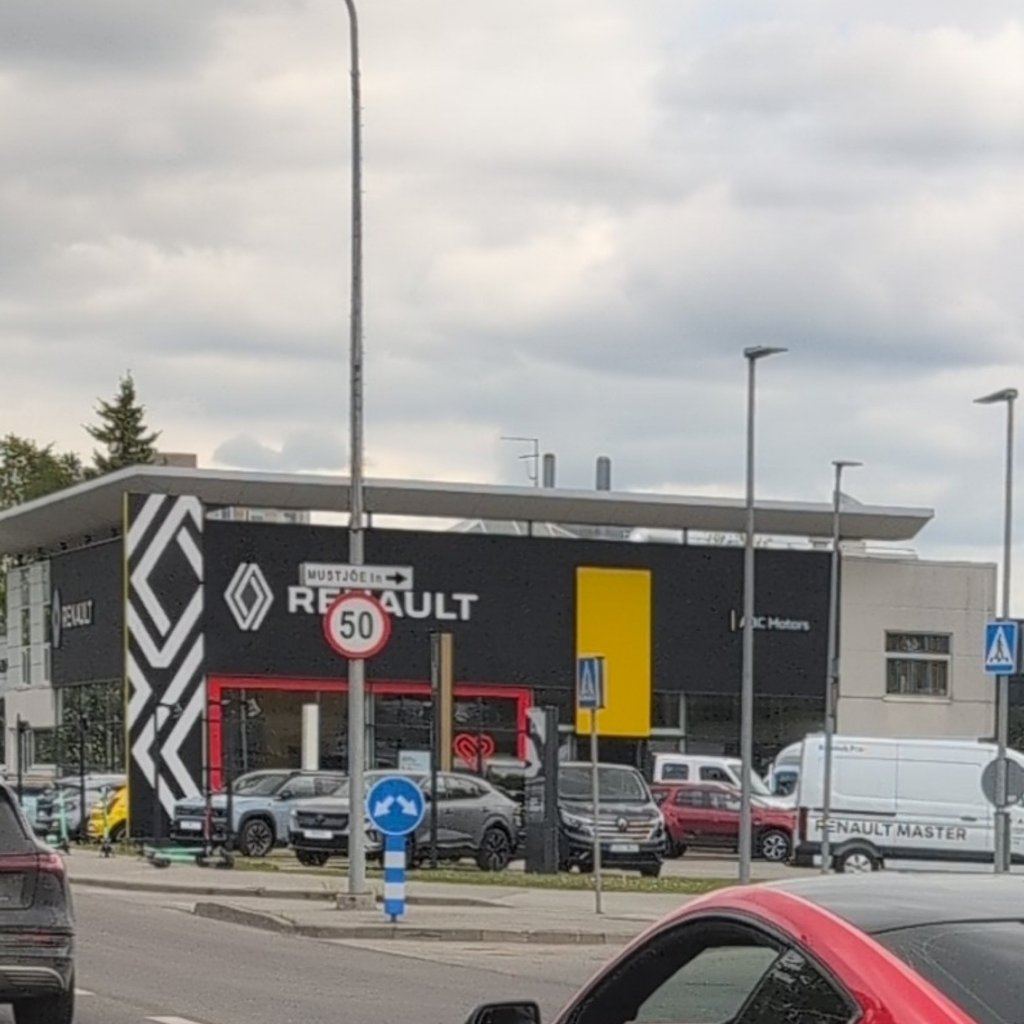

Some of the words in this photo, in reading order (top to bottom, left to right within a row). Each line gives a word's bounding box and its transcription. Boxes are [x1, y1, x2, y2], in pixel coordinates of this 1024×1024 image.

[287, 586, 480, 621] REAULT
[340, 611, 374, 640] 50
[896, 825, 967, 841] MASTER
